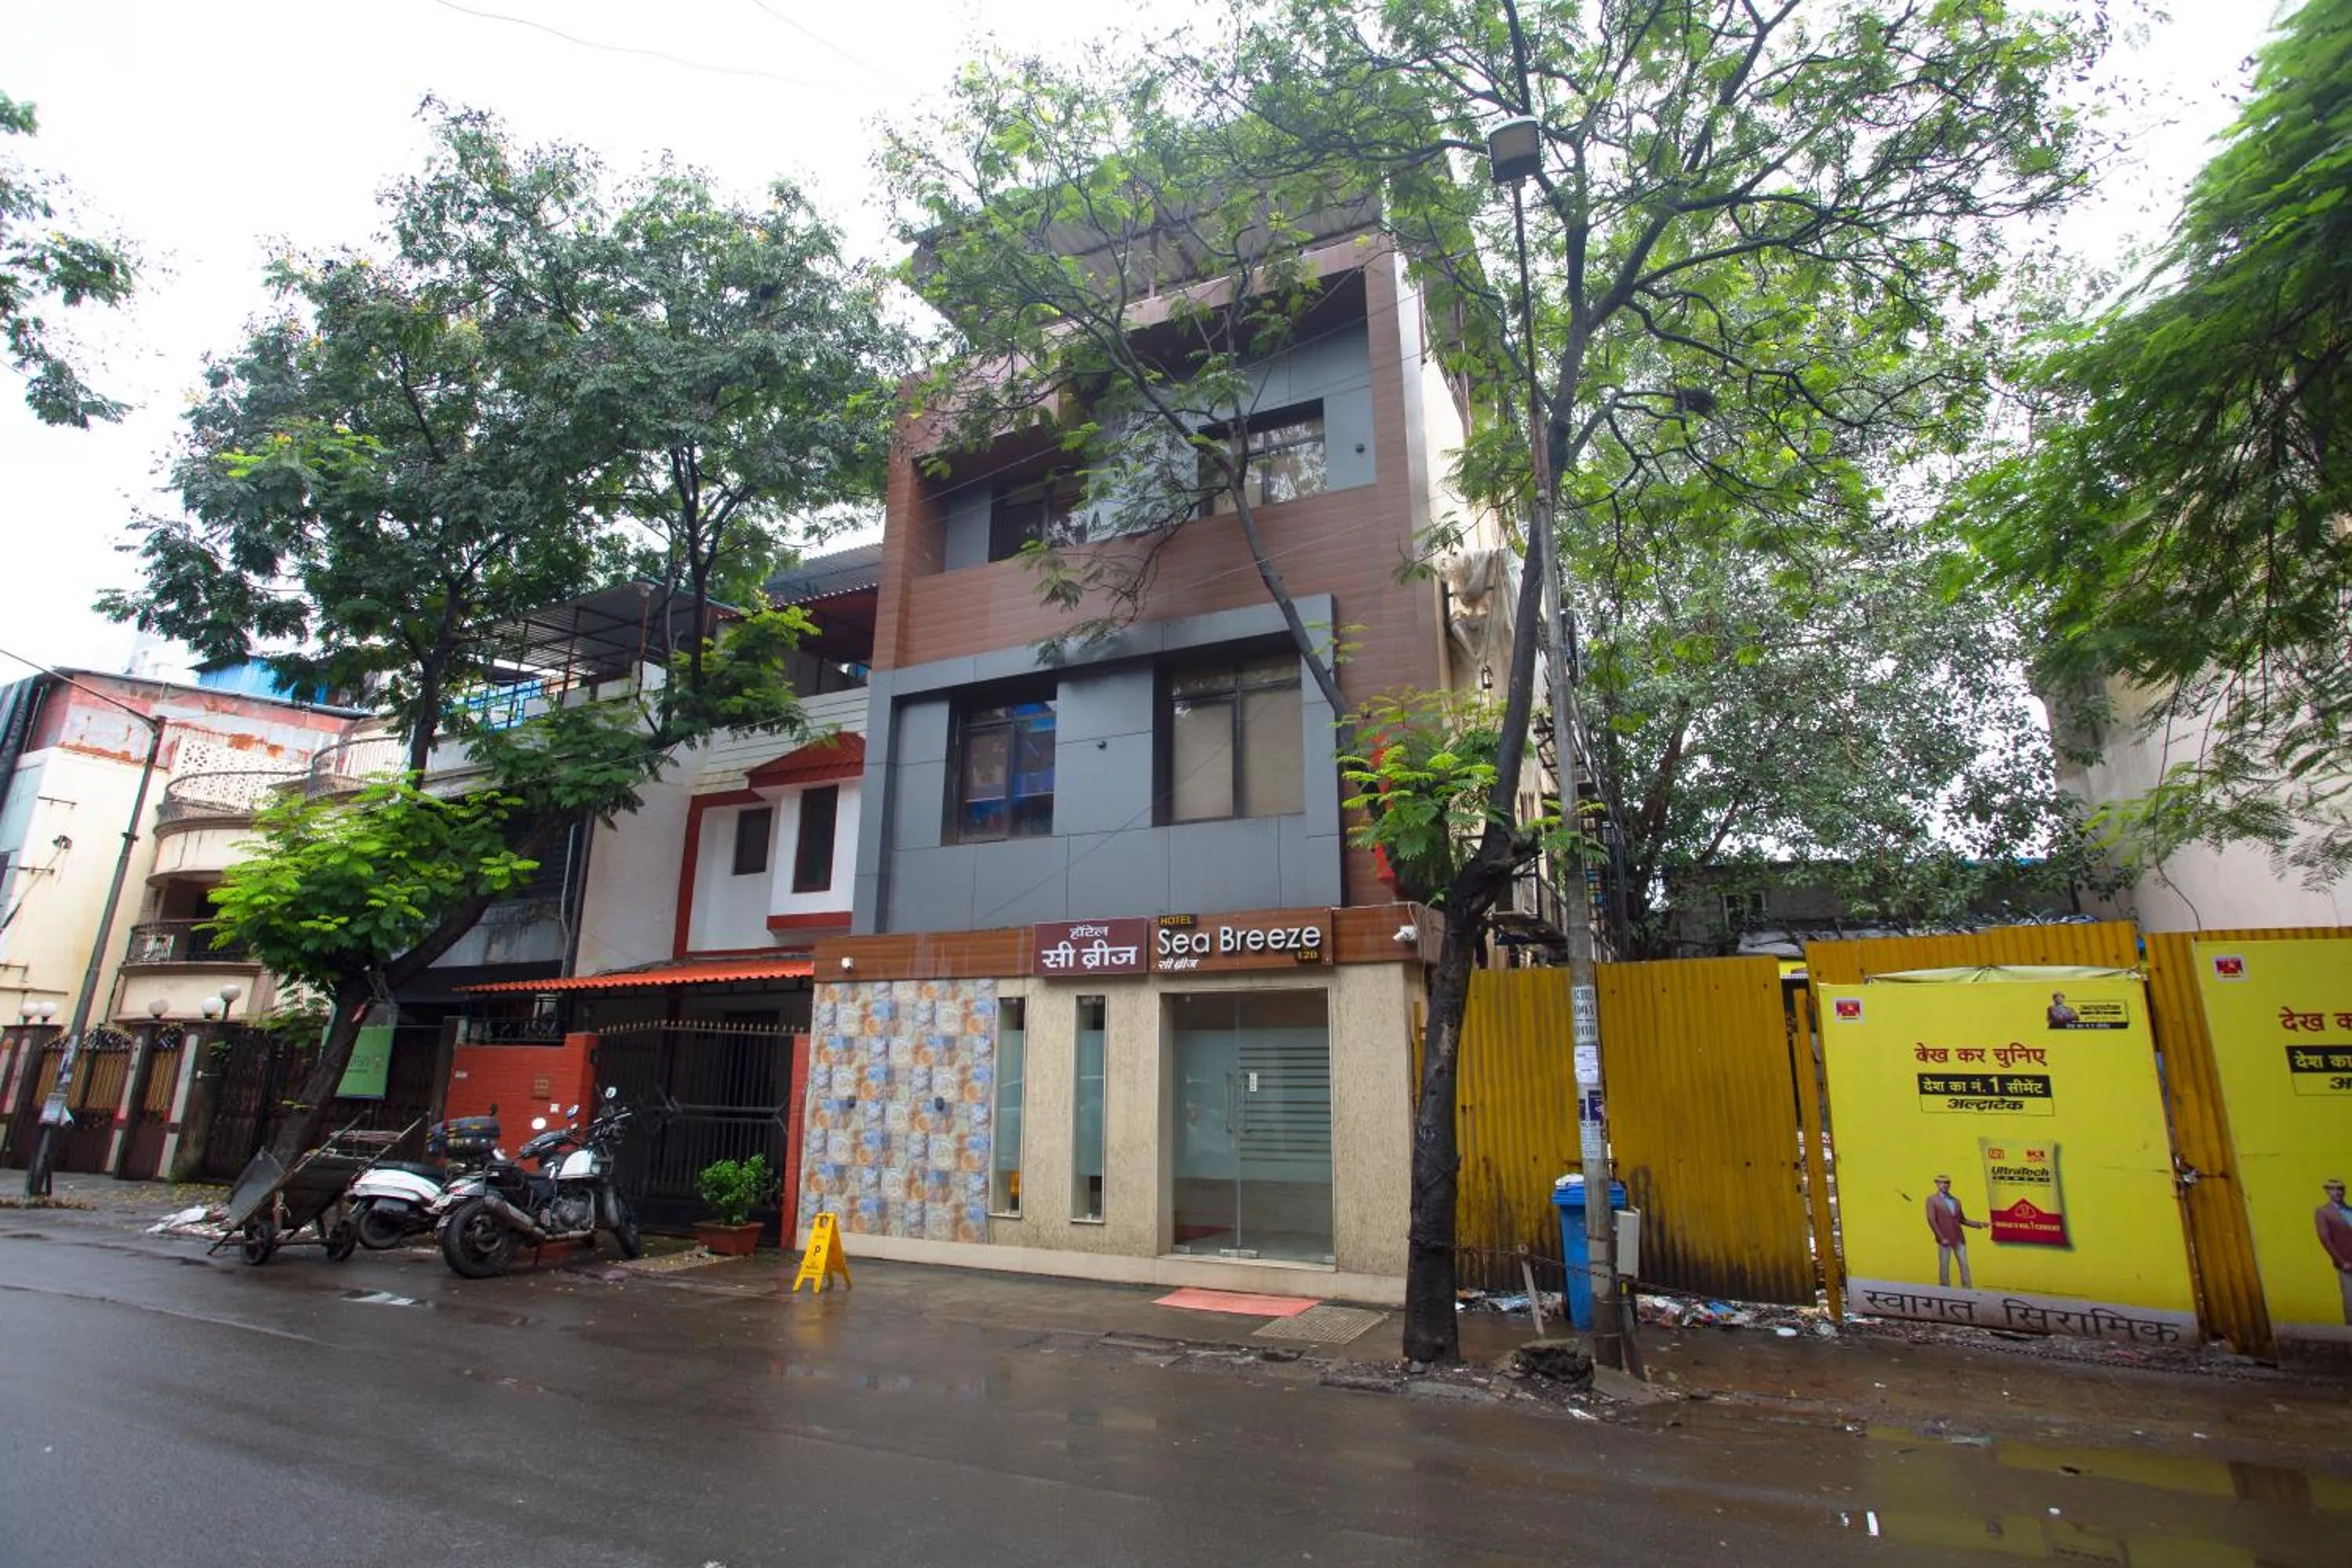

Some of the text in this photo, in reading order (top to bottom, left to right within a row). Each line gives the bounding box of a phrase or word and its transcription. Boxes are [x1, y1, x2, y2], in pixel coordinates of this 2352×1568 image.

[1069, 924, 1109, 939] हॉटेल
[1160, 916, 1192, 926] HOTEL
[1157, 926, 1321, 954] Sea Breeze
[1041, 938, 1138, 970] सी ब्रीज
[2278, 1006, 2325, 1032] देख
[1956, 1048, 1986, 1063] कर
[1993, 1042, 2048, 1068] चुनिए
[1949, 1080, 1967, 1092] का
[1991, 1166, 2049, 1177] UltraTech
[1863, 1289, 2182, 1344] स्वागत सिरामिक
